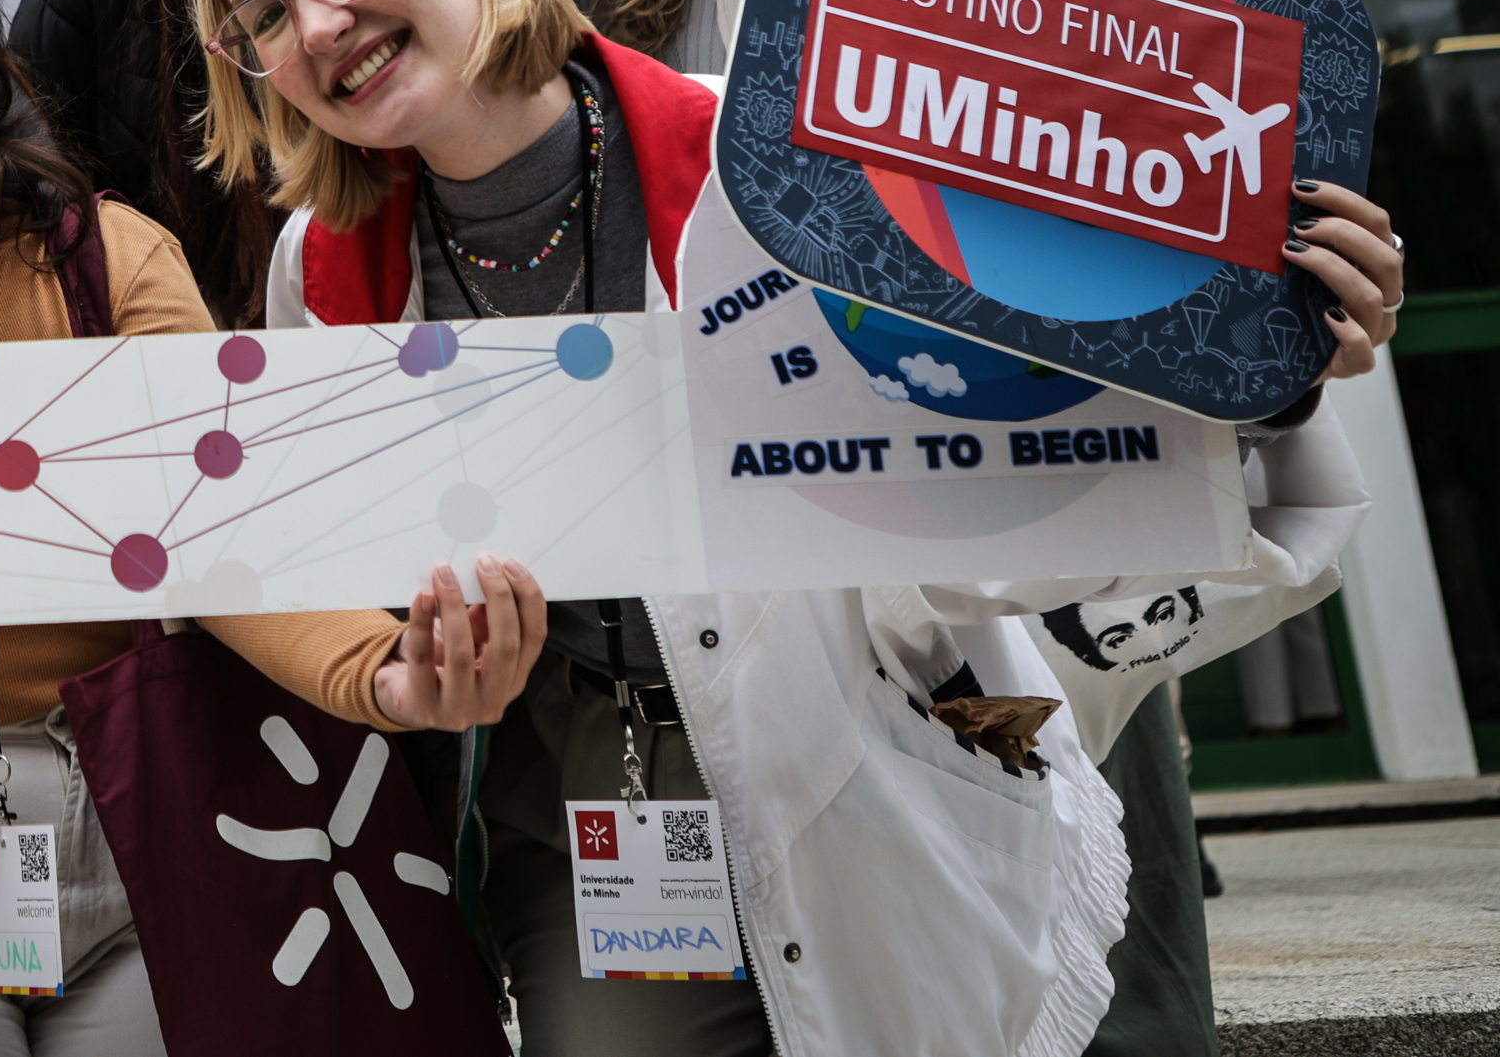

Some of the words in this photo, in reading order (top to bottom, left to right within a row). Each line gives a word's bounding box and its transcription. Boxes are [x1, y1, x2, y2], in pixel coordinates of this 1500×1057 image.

[1060, 2, 1194, 80] FINAL
[833, 43, 1185, 208] UMinho
[769, 344, 819, 386] IS
[730, 436, 891, 478] ABOUT
[916, 433, 983, 470] TO
[1010, 425, 1160, 467] BEGIN
[1129, 653, 1162, 669] Frida
[1162, 635, 1191, 659] Kahlo
[580, 874, 635, 885] Universidade
[581, 888, 592, 898] do
[593, 888, 621, 899] Minho
[660, 885, 724, 900] bem-vindo!
[16, 904, 55, 919] welcome!
[589, 926, 724, 955] DANDARA
